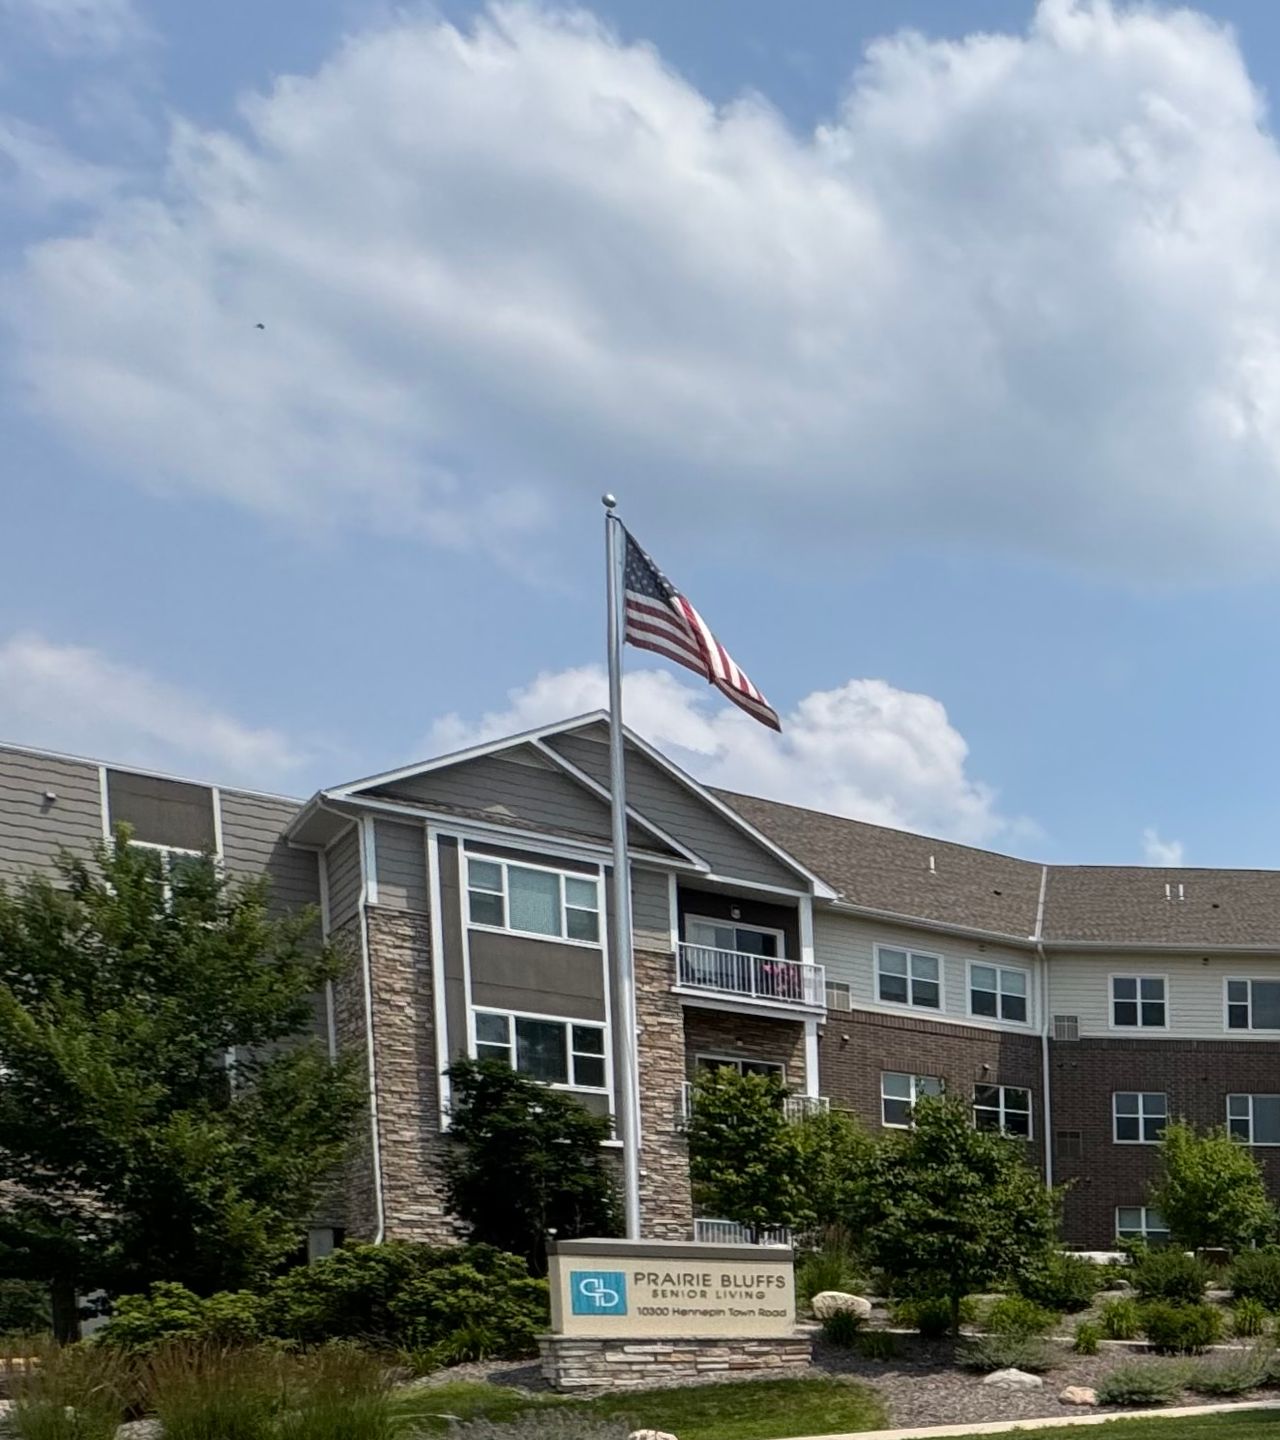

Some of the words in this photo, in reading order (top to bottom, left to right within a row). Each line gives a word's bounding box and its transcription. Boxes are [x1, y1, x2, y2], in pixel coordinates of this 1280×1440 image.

[634, 1272, 712, 1287] PRAIRIE
[721, 1274, 786, 1289] BLUFFS
[652, 1289, 707, 1299] SENIOR
[715, 1290, 766, 1299] LIVING
[637, 1307, 669, 1316] 10300
[672, 1307, 726, 1318] Hennepin
[728, 1308, 756, 1317] Town
[758, 1308, 787, 1317] Road
